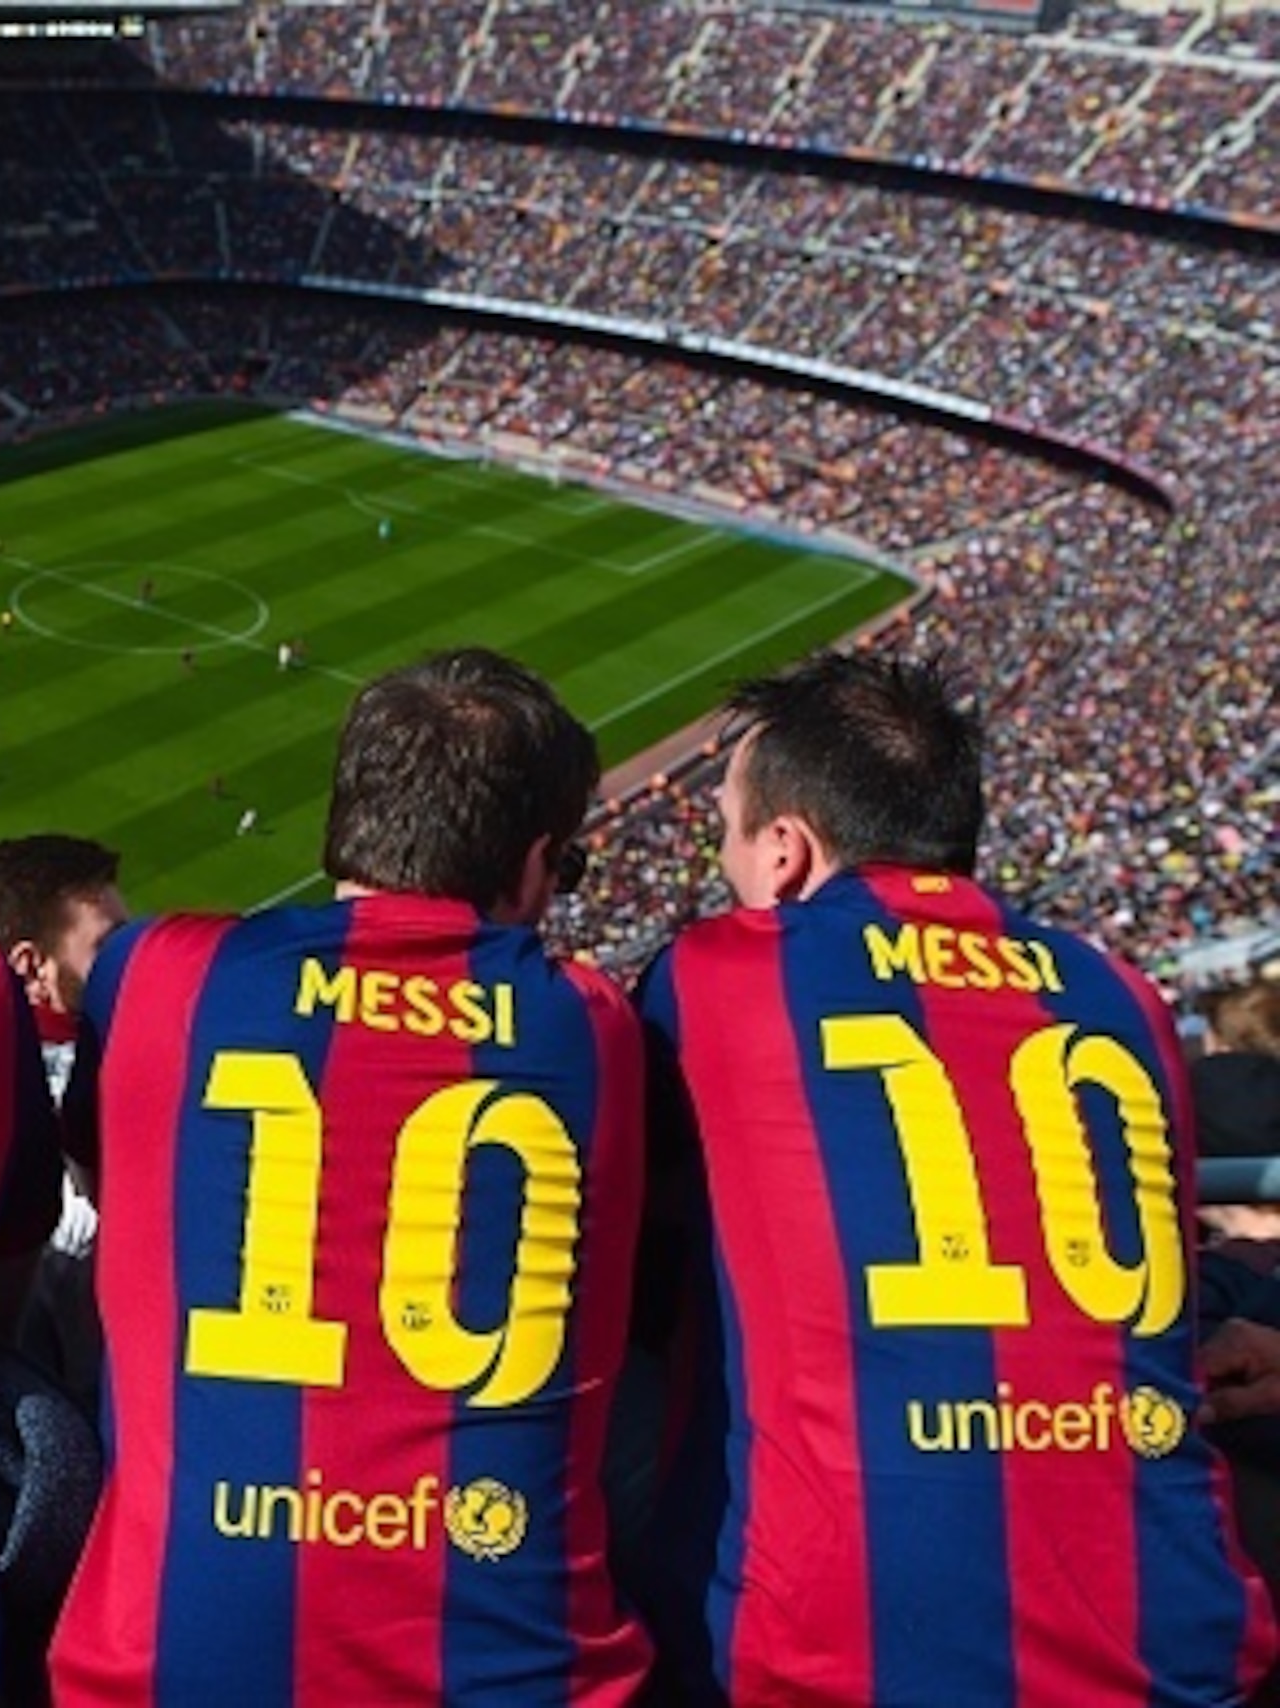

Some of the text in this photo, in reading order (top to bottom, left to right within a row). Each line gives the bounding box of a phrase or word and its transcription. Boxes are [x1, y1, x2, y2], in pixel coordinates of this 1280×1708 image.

[862, 922, 1062, 994] MESSI
[294, 956, 516, 1048] MESSI
[820, 1014, 1186, 1338] 10
[184, 1050, 583, 1408] 10
[907, 1385, 1115, 1452] unicef
[214, 1470, 437, 1551] unicef
